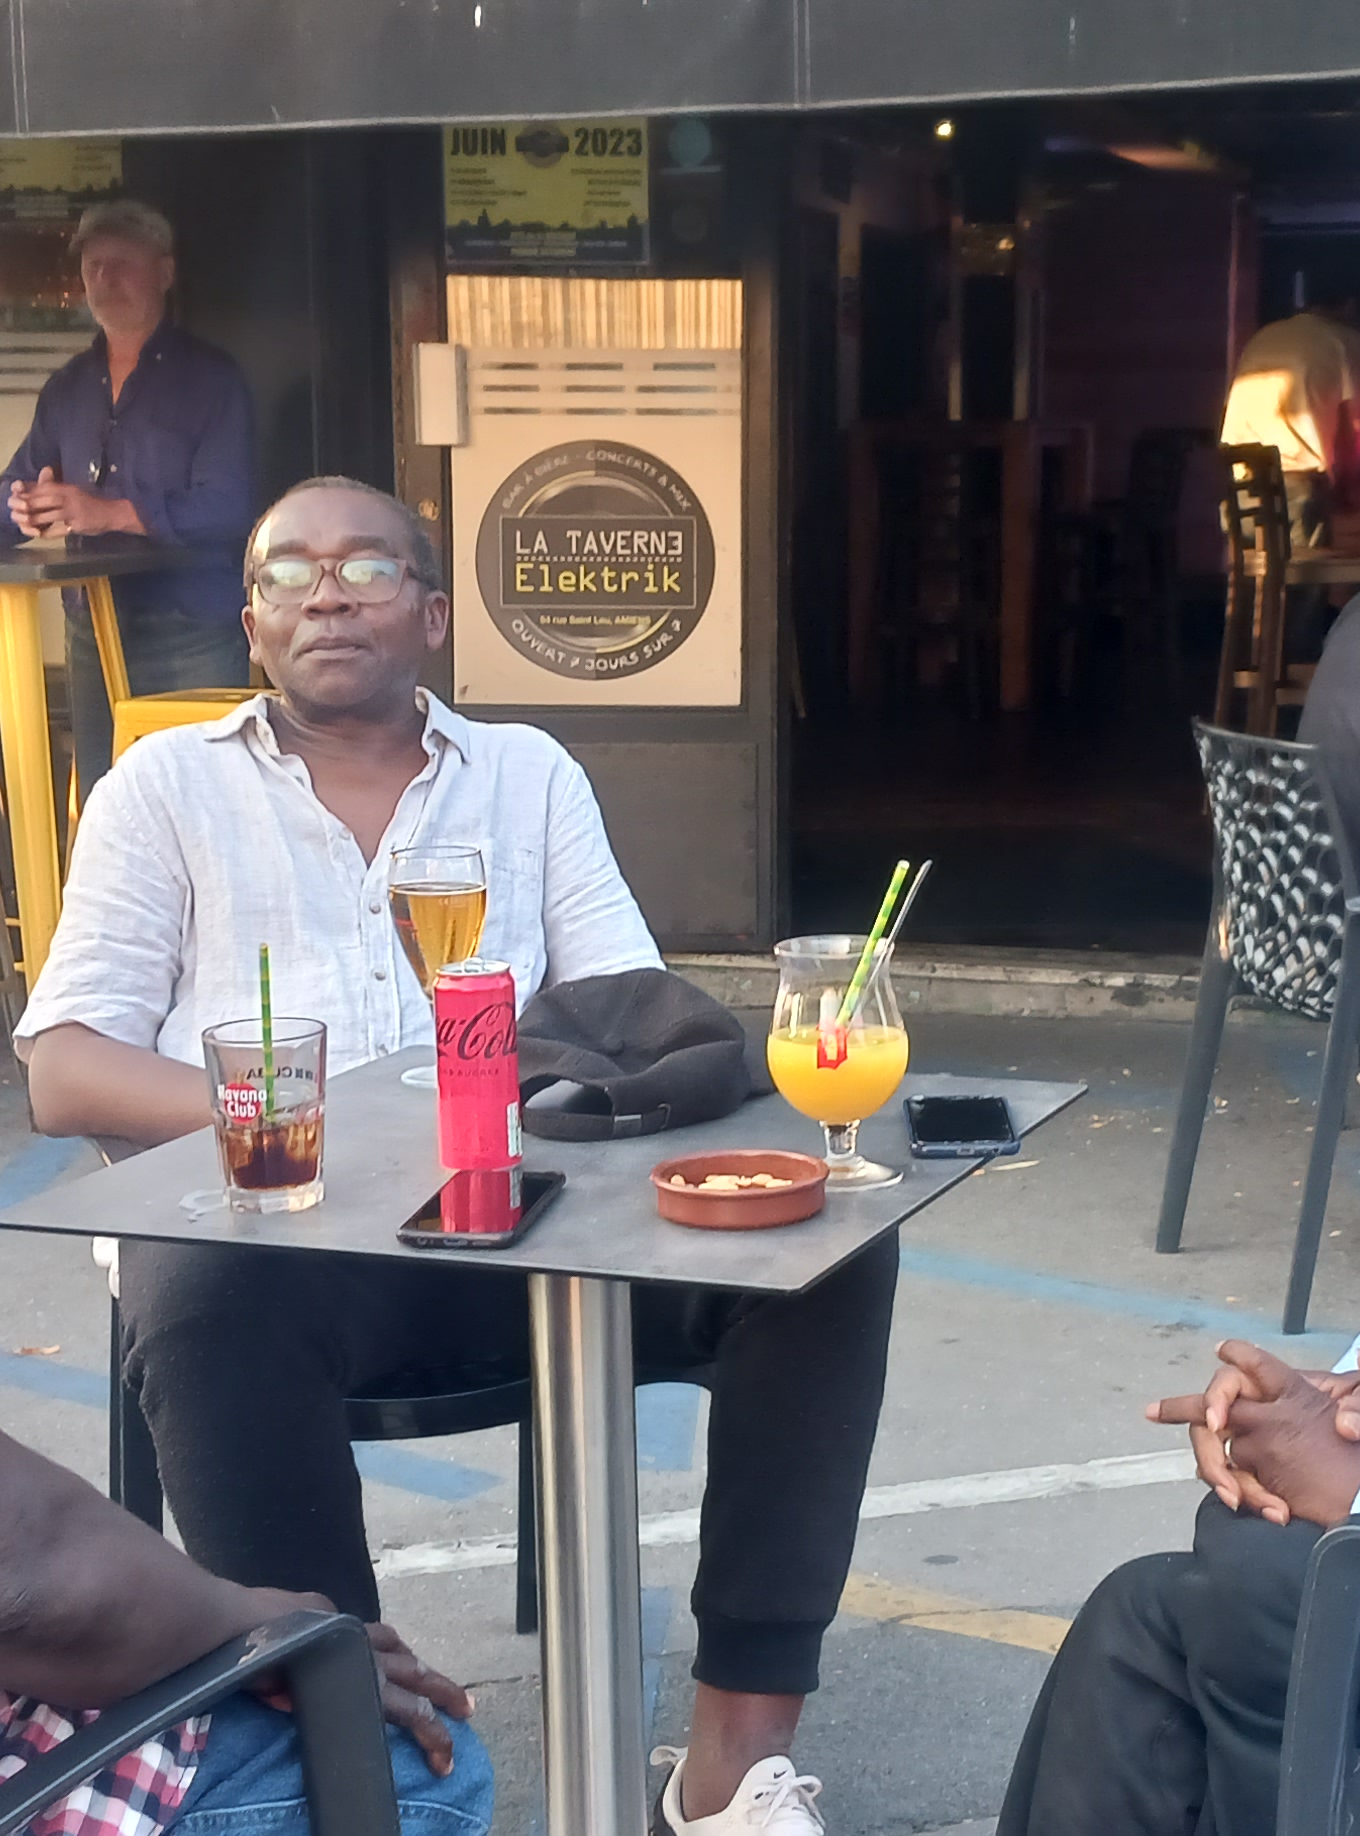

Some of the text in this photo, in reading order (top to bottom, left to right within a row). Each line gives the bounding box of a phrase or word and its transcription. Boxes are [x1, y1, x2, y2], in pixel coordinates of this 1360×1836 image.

[451, 127, 506, 157] JUIN
[575, 127, 643, 157] 2023
[585, 450, 658, 478] CONCERTS
[668, 483, 691, 512] MIX
[515, 529, 548, 555] LA
[515, 562, 681, 593] Elektrik
[511, 618, 566, 665] OUVERT
[585, 651, 639, 671] JOURS
[643, 632, 673, 659] SUR
[217, 1083, 267, 1101] Havana
[227, 1100, 257, 1117] Club
